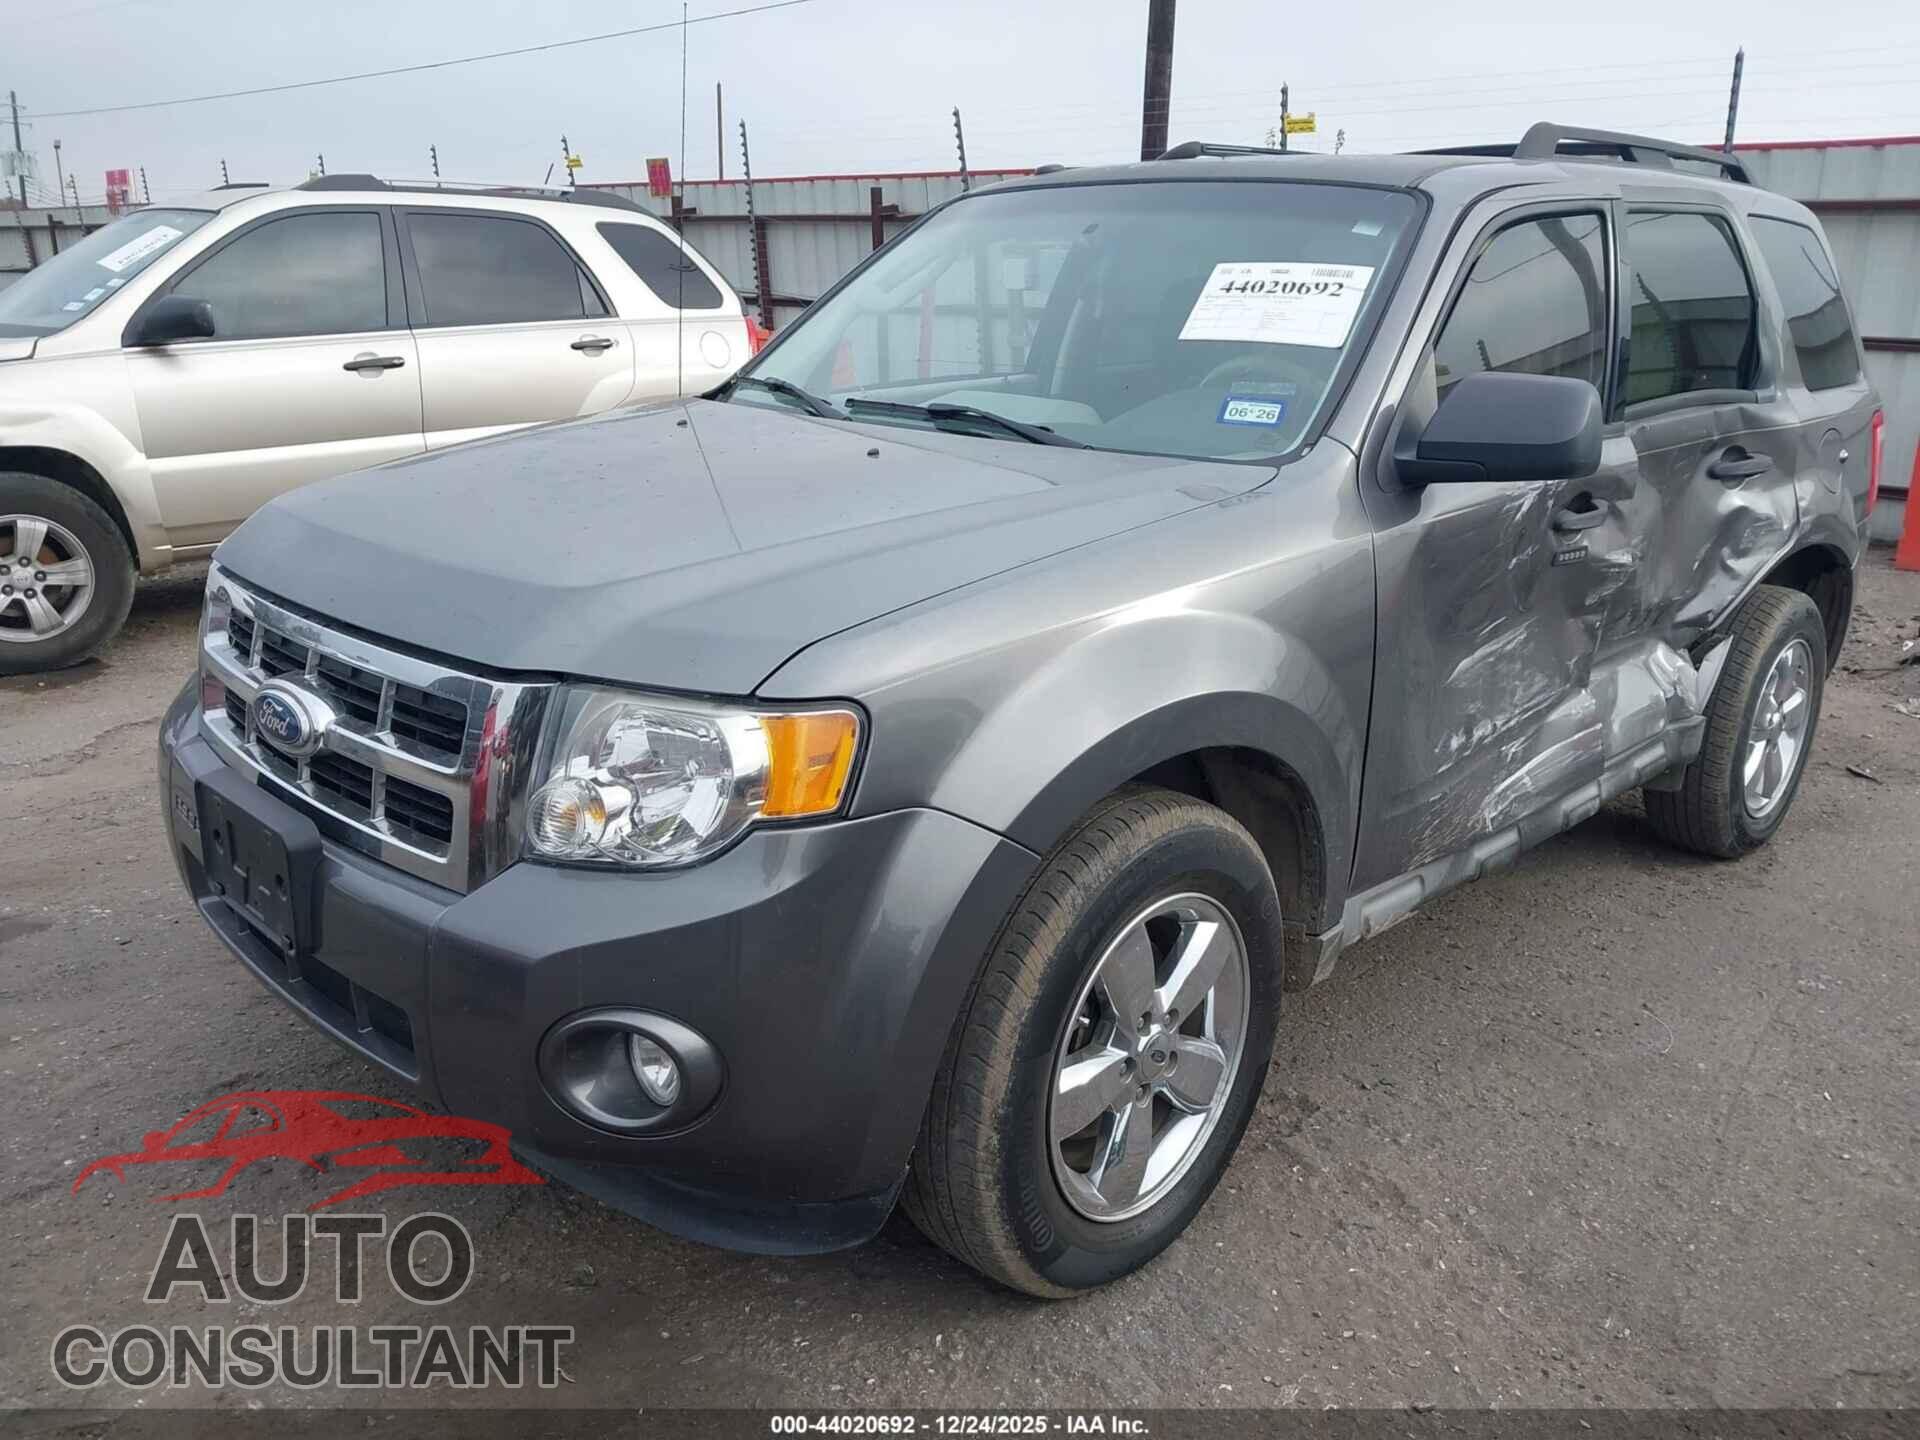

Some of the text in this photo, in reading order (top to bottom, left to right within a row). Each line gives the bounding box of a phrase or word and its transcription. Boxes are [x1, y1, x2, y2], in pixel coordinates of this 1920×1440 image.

[1220, 280, 1344, 297] 44020692
[1228, 407, 1277, 420] 06 26
[259, 698, 291, 737] Ford
